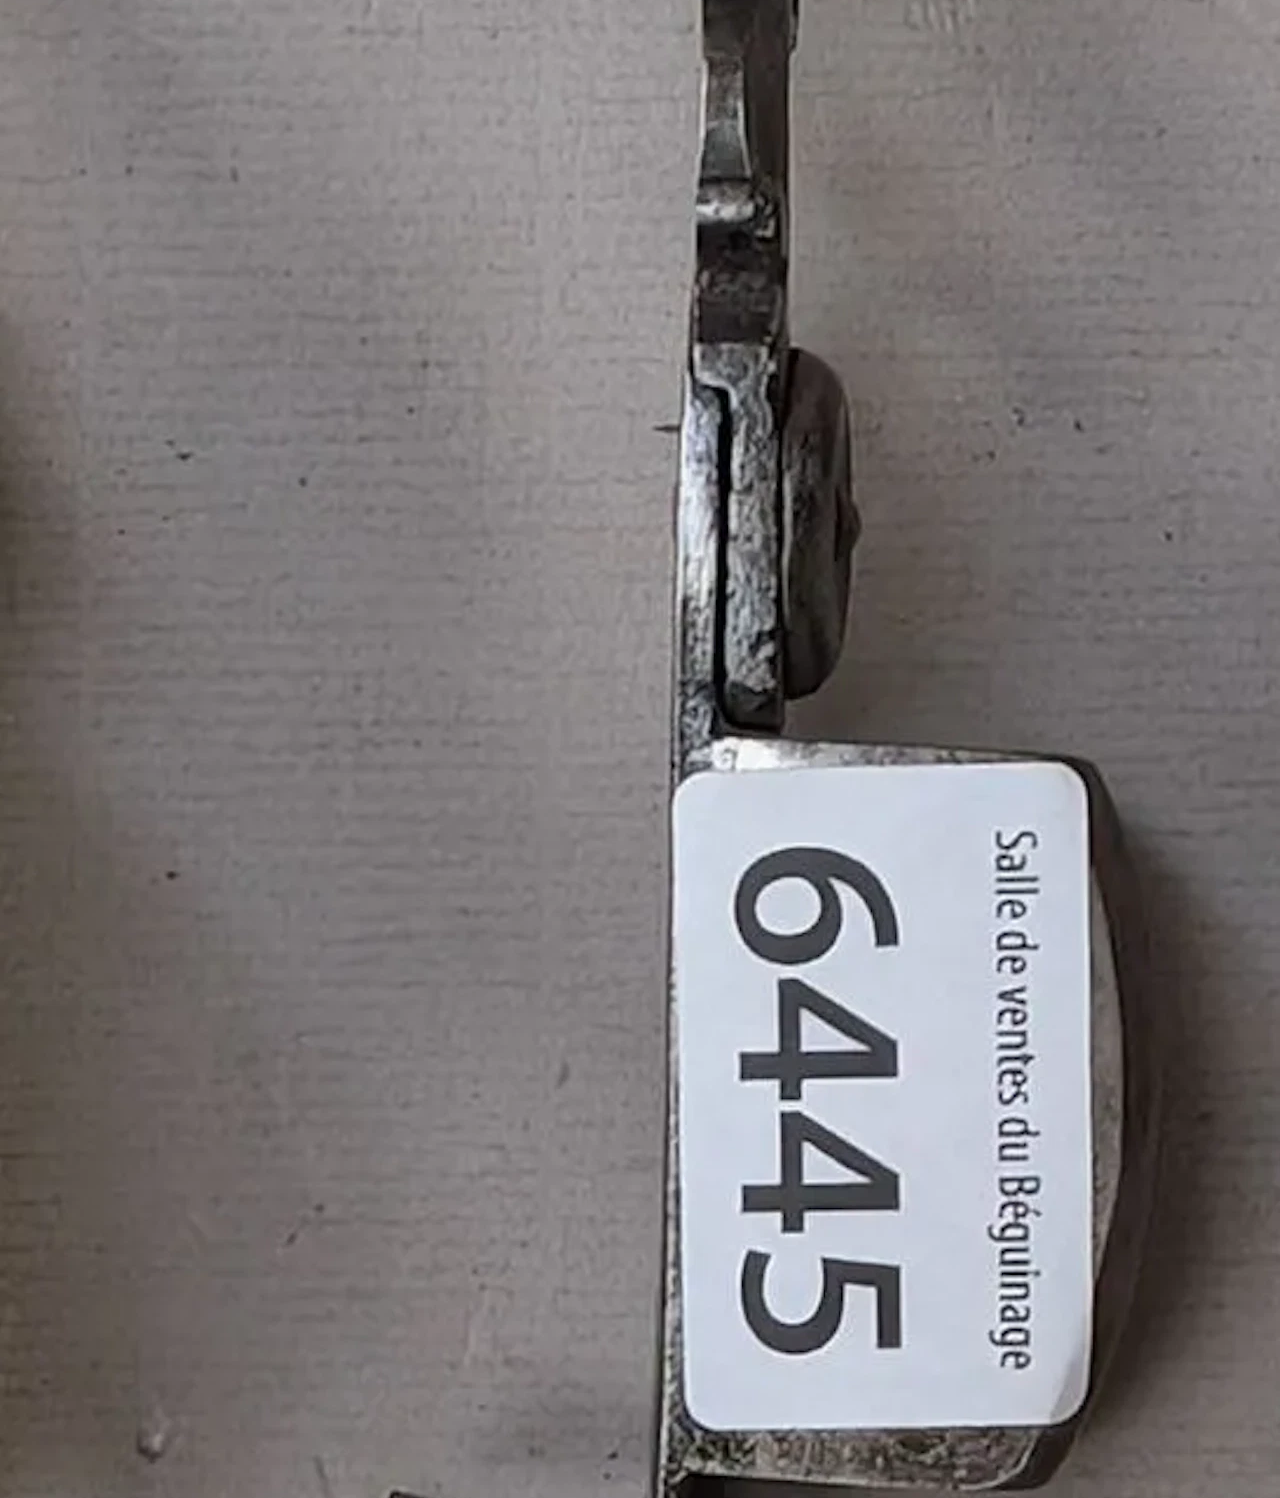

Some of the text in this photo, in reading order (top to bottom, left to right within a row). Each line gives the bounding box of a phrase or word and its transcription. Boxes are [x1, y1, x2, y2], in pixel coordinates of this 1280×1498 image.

[732, 845, 903, 1357] 6445
[987, 830, 1042, 1371] Salle de ventes du Béguinage
